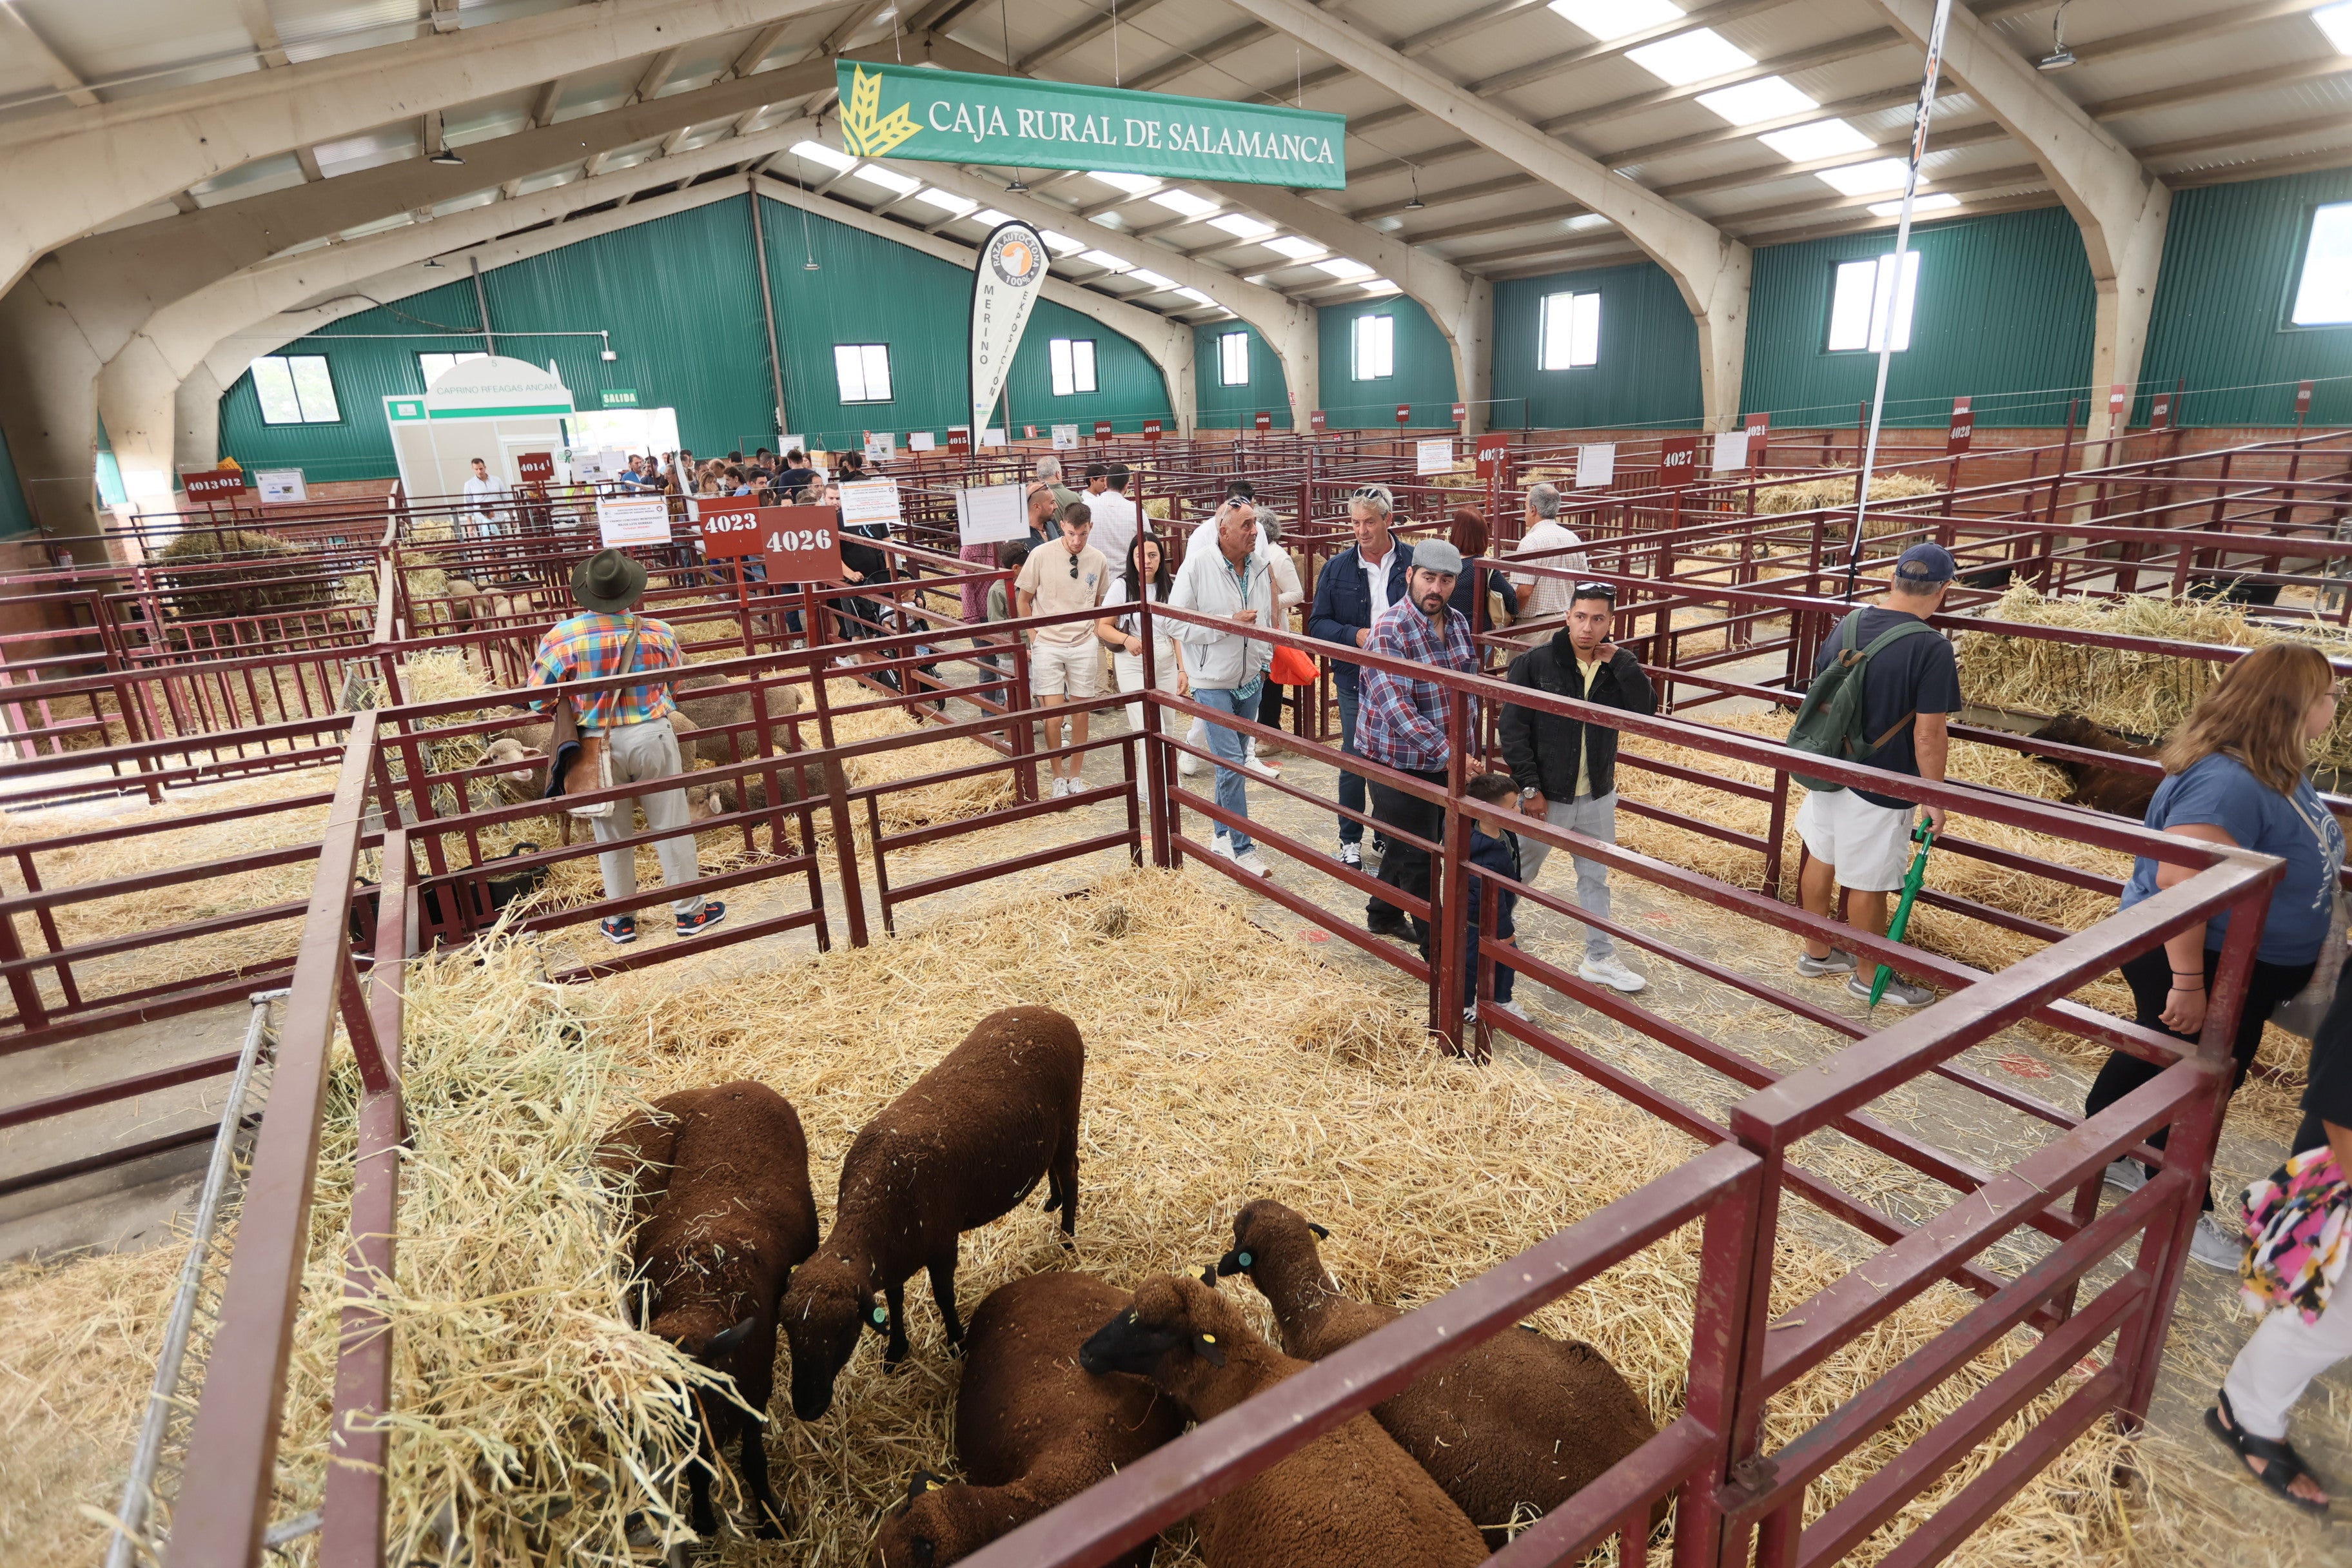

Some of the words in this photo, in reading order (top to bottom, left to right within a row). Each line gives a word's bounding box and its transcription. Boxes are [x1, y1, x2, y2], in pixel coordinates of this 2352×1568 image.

[928, 101, 1010, 144] CAJA
[1016, 108, 1117, 146] RURAL
[1124, 119, 1162, 150] DE
[1168, 122, 1335, 165] SALAMANCA
[993, 241, 1004, 267] RAZA
[1003, 232, 1040, 268] AUTÓCTONA
[1006, 275, 1031, 286] 100%
[979, 284, 994, 365] MERINO
[988, 290, 1028, 397] EXPOSICIÓN
[491, 359, 498, 368] 5
[436, 386, 479, 395] CAPRINO
[525, 382, 558, 392] ANCAM
[603, 393, 636, 403] SALIDA
[2152, 404, 2168, 416] 4029
[1747, 424, 1766, 437] 4021
[1950, 425, 1971, 440] 4028
[948, 436, 967, 445] 4015
[1663, 450, 1693, 467] 4027
[520, 462, 546, 472] 4014
[188, 480, 219, 491] 4013
[705, 513, 758, 534] 4023
[766, 529, 832, 553] 4026
